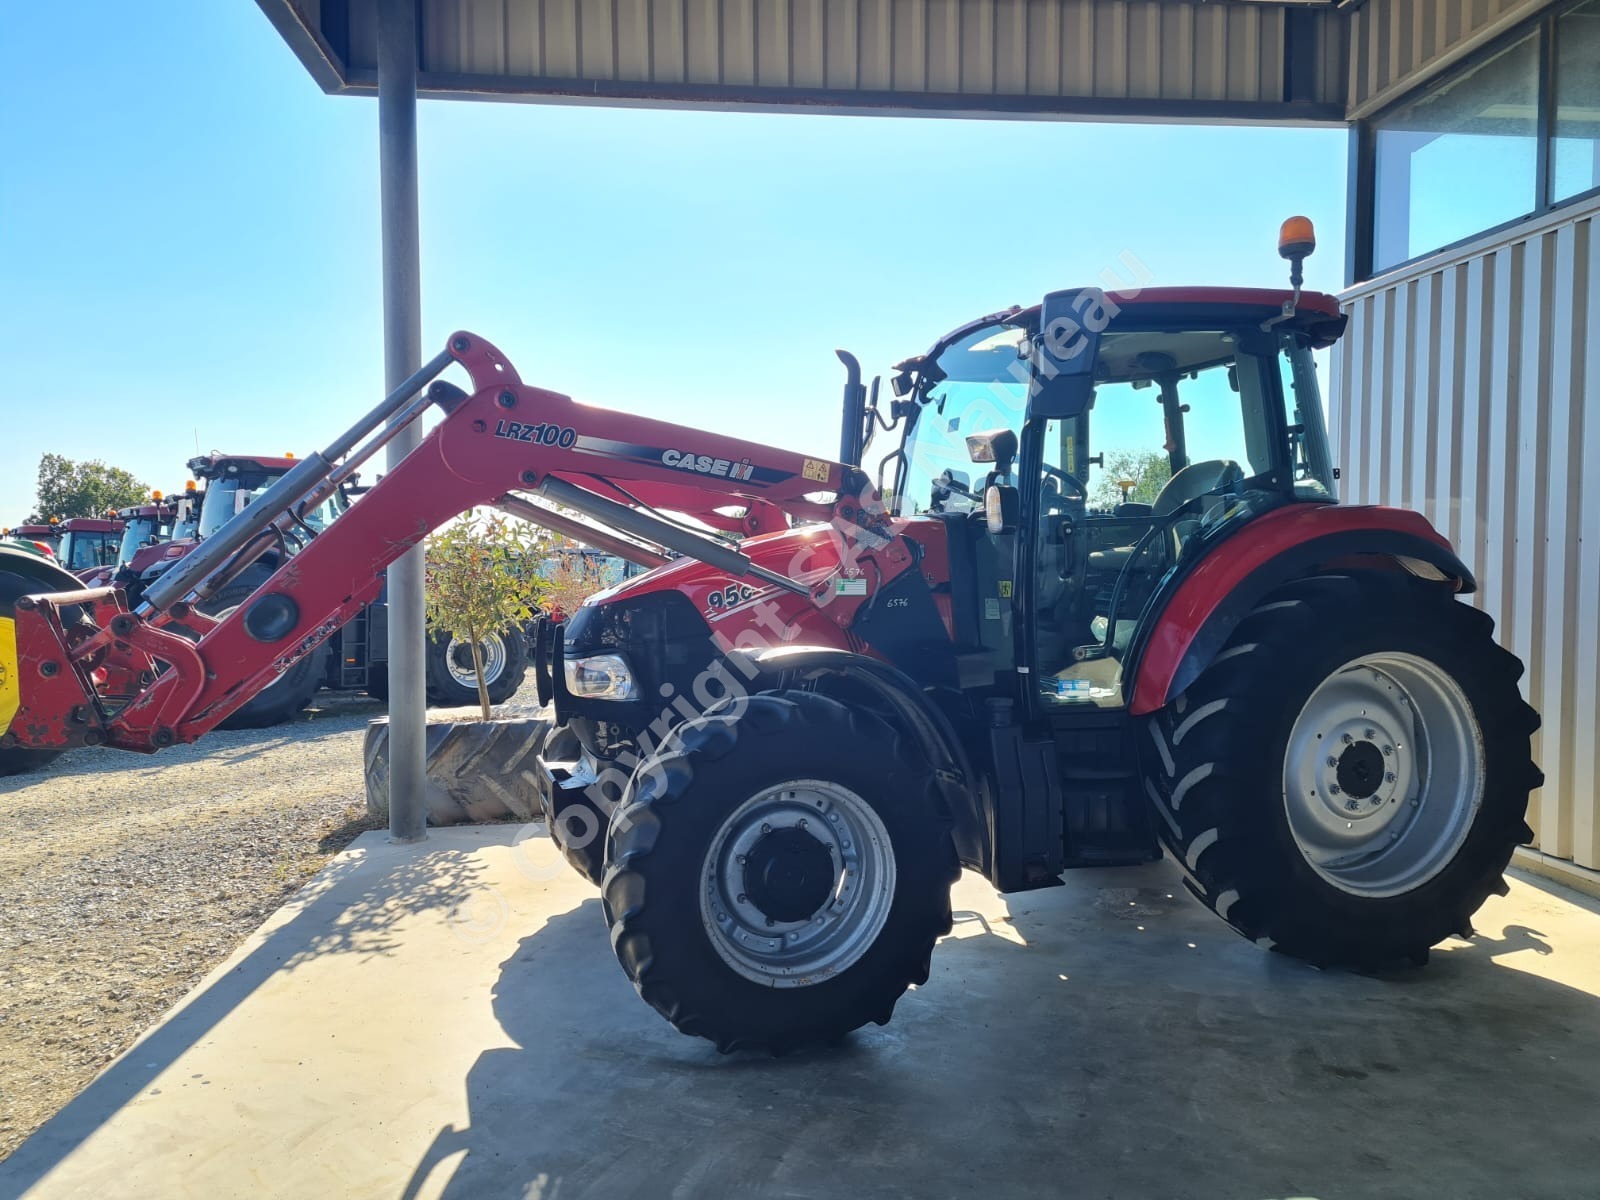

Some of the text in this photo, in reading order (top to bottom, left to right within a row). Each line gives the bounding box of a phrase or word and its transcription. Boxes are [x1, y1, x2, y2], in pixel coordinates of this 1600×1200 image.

[494, 420, 577, 449] LRZ100
[661, 449, 730, 475] CASE
[887, 598, 909, 608] 6576
